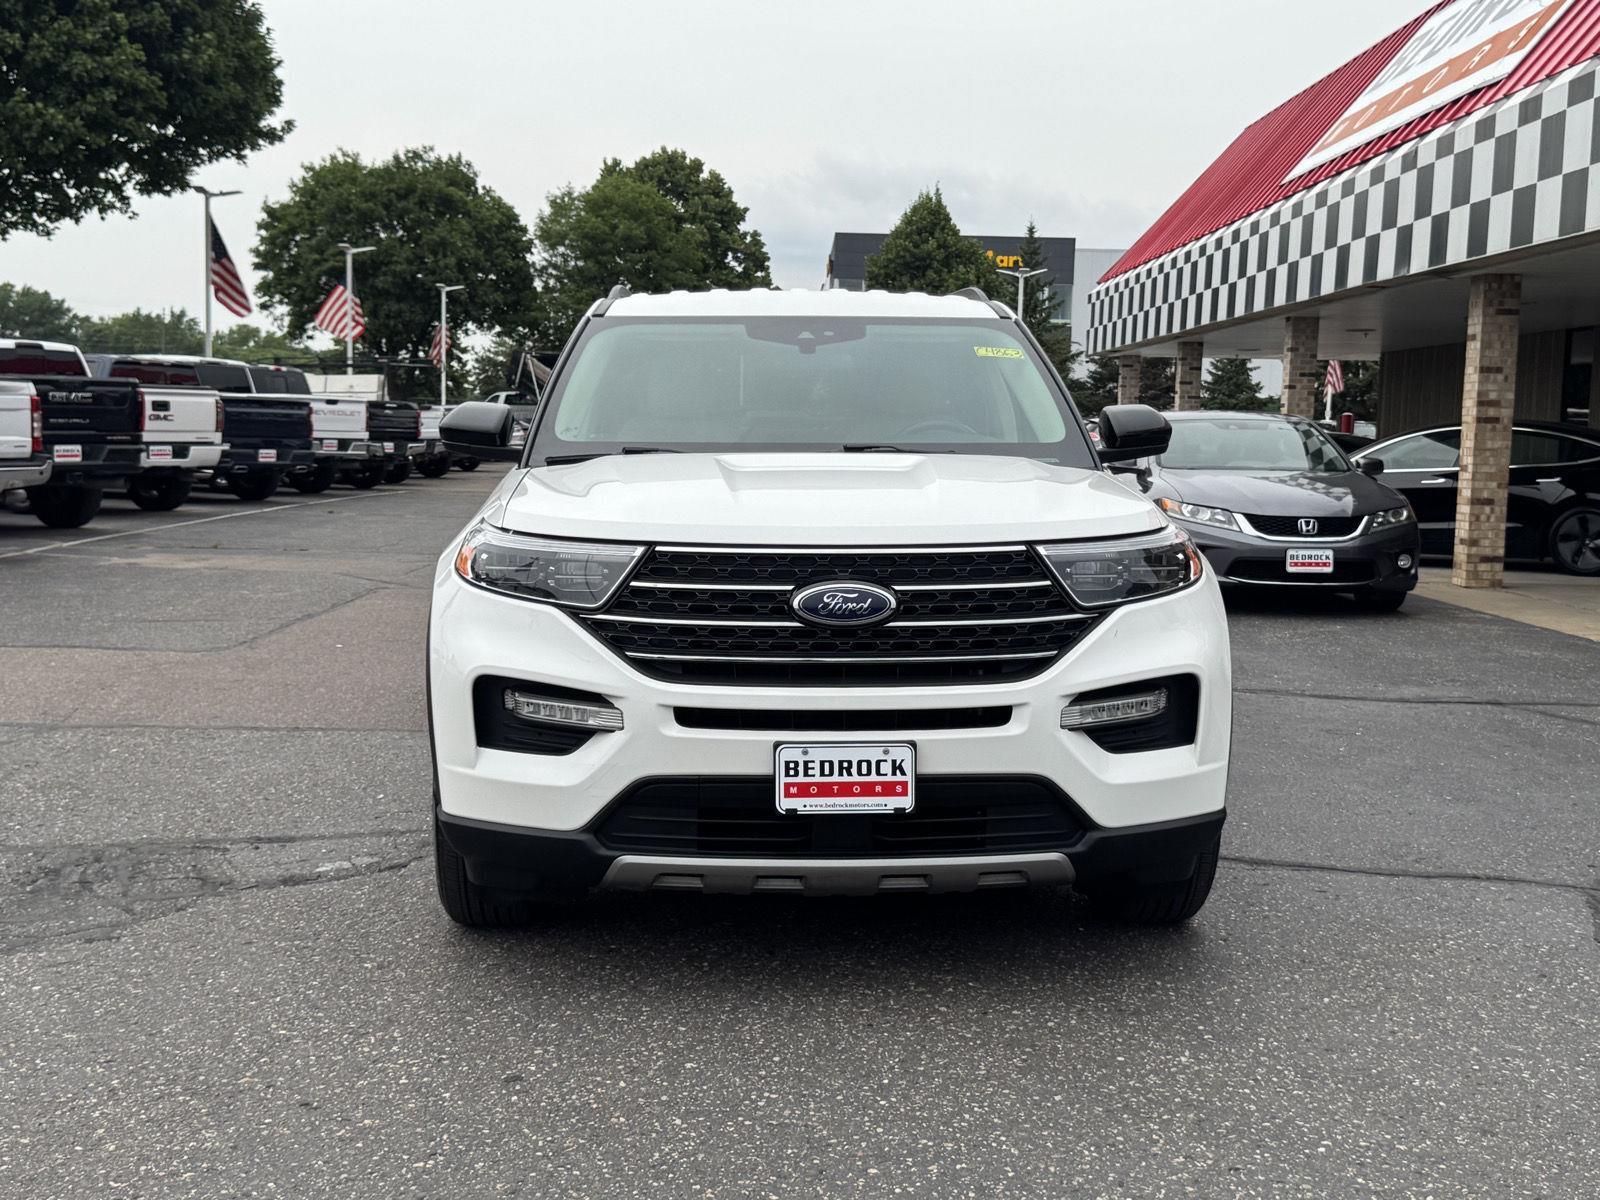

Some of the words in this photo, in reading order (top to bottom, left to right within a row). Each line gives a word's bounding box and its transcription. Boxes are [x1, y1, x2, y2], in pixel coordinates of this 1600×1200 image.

[148, 413, 175, 422] GMC
[1289, 553, 1331, 561] BEDROCK
[818, 592, 873, 615] Ford
[784, 758, 907, 777] BEDROCK
[789, 785, 903, 794] MOTORS
[809, 801, 884, 809] www.bedrockmotors.com
